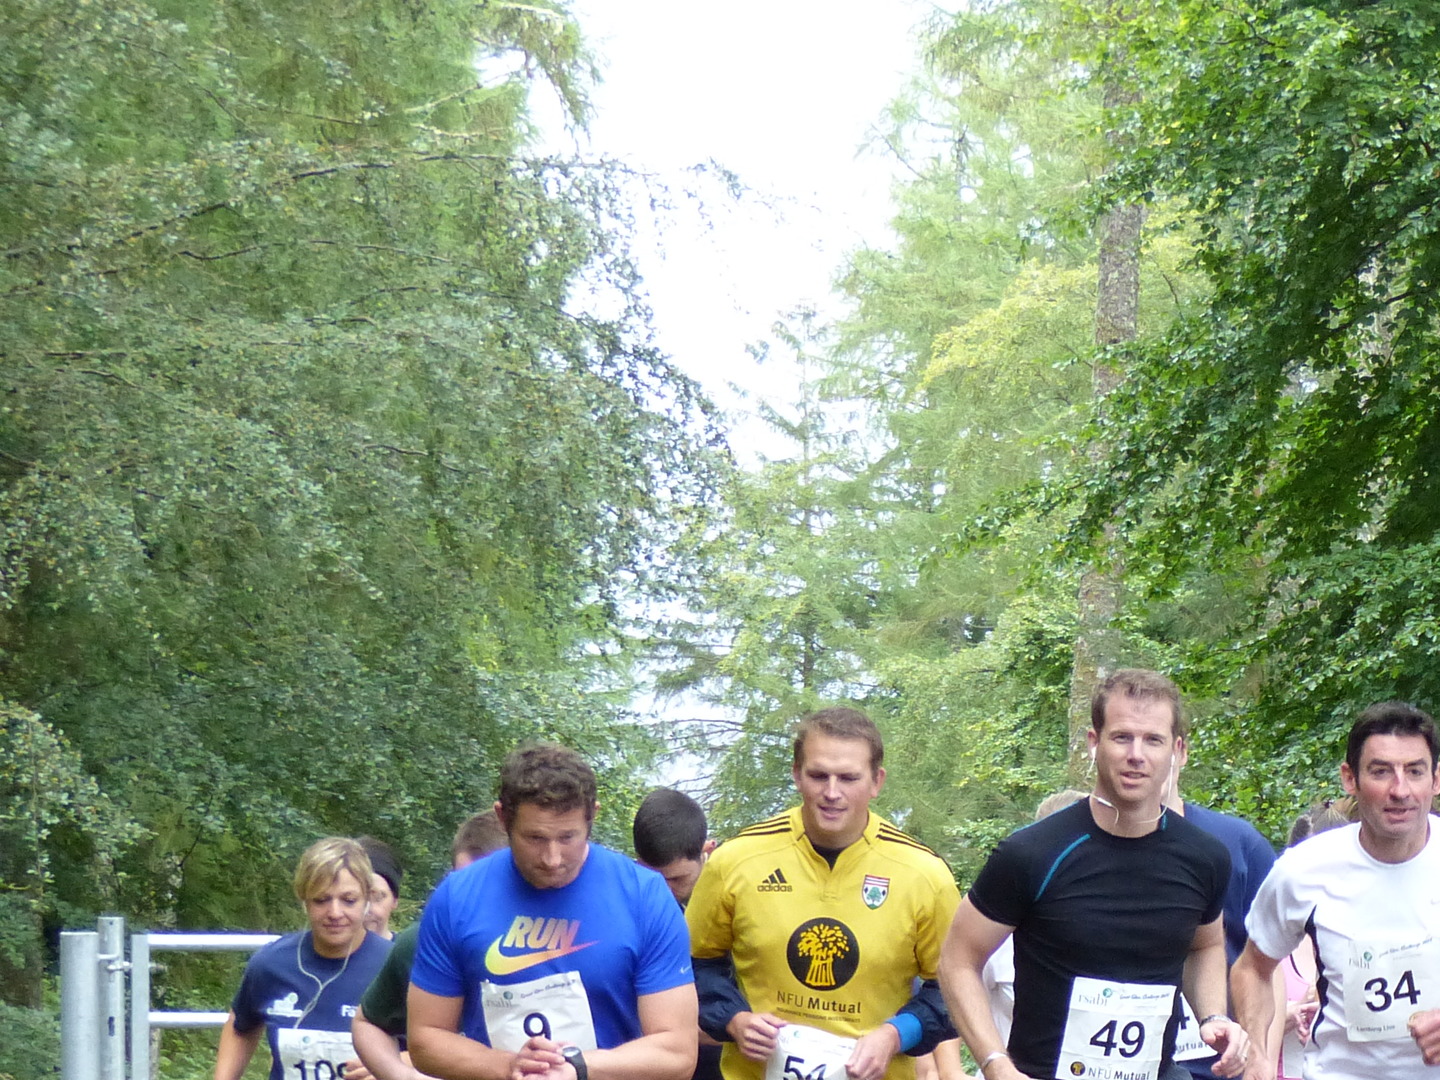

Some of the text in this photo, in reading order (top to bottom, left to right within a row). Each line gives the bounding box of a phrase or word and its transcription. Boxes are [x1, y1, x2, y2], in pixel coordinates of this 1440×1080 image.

[757, 883, 793, 892] adidas
[503, 915, 582, 950] RUN
[776, 990, 861, 1014] NFU Mutual
[1364, 970, 1421, 1012] 34
[523, 1012, 552, 1040] 9
[1089, 1019, 1145, 1058] 49
[1176, 1040, 1209, 1054] utua
[1088, 1067, 1150, 1080] NFU Mutual
